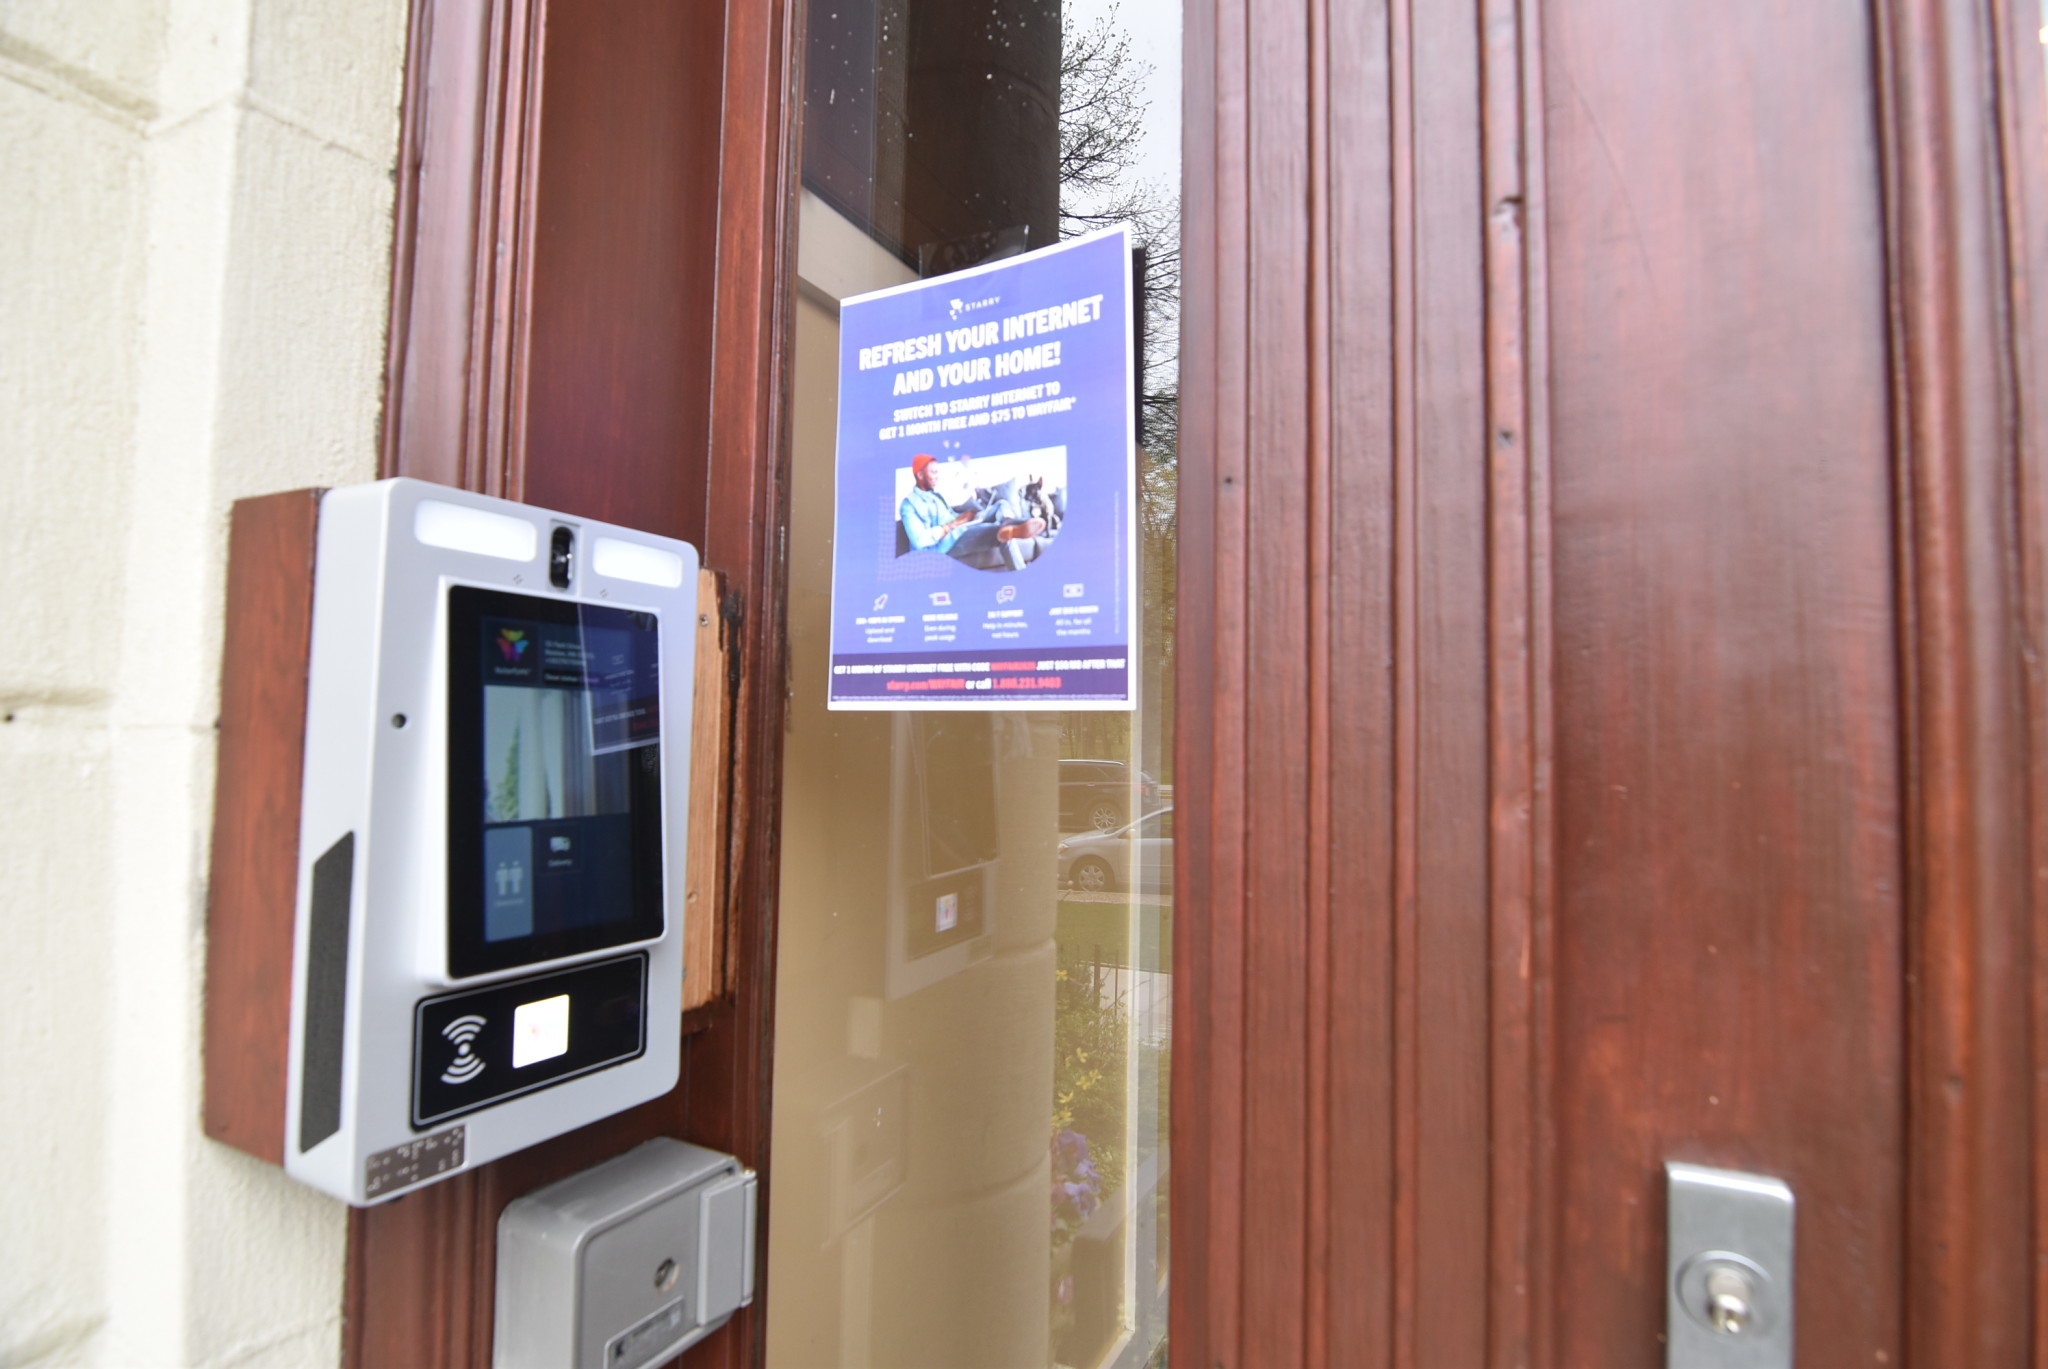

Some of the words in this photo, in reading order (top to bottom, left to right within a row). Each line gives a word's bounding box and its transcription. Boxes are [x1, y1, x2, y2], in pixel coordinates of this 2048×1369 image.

[965, 296, 1001, 312] STARRY
[859, 333, 942, 371] REFRESH
[945, 323, 999, 355] YOUR
[1003, 294, 1104, 341] INTERNET
[893, 371, 934, 396] AND
[937, 356, 991, 389] YOUR
[995, 341, 1062, 378] HOME!
[893, 405, 933, 423] SWITCH
[934, 401, 949, 417] TO
[949, 394, 990, 415] STARRY
[991, 384, 1044, 406] INTERNET
[1045, 380, 1061, 397] TO
[879, 426, 897, 441] GET
[898, 424, 904, 437] 1
[905, 419, 941, 436] MONTH
[942, 415, 968, 431] FREE
[968, 412, 990, 427] AND
[990, 408, 1011, 424] $75
[1011, 406, 1026, 420] TO
